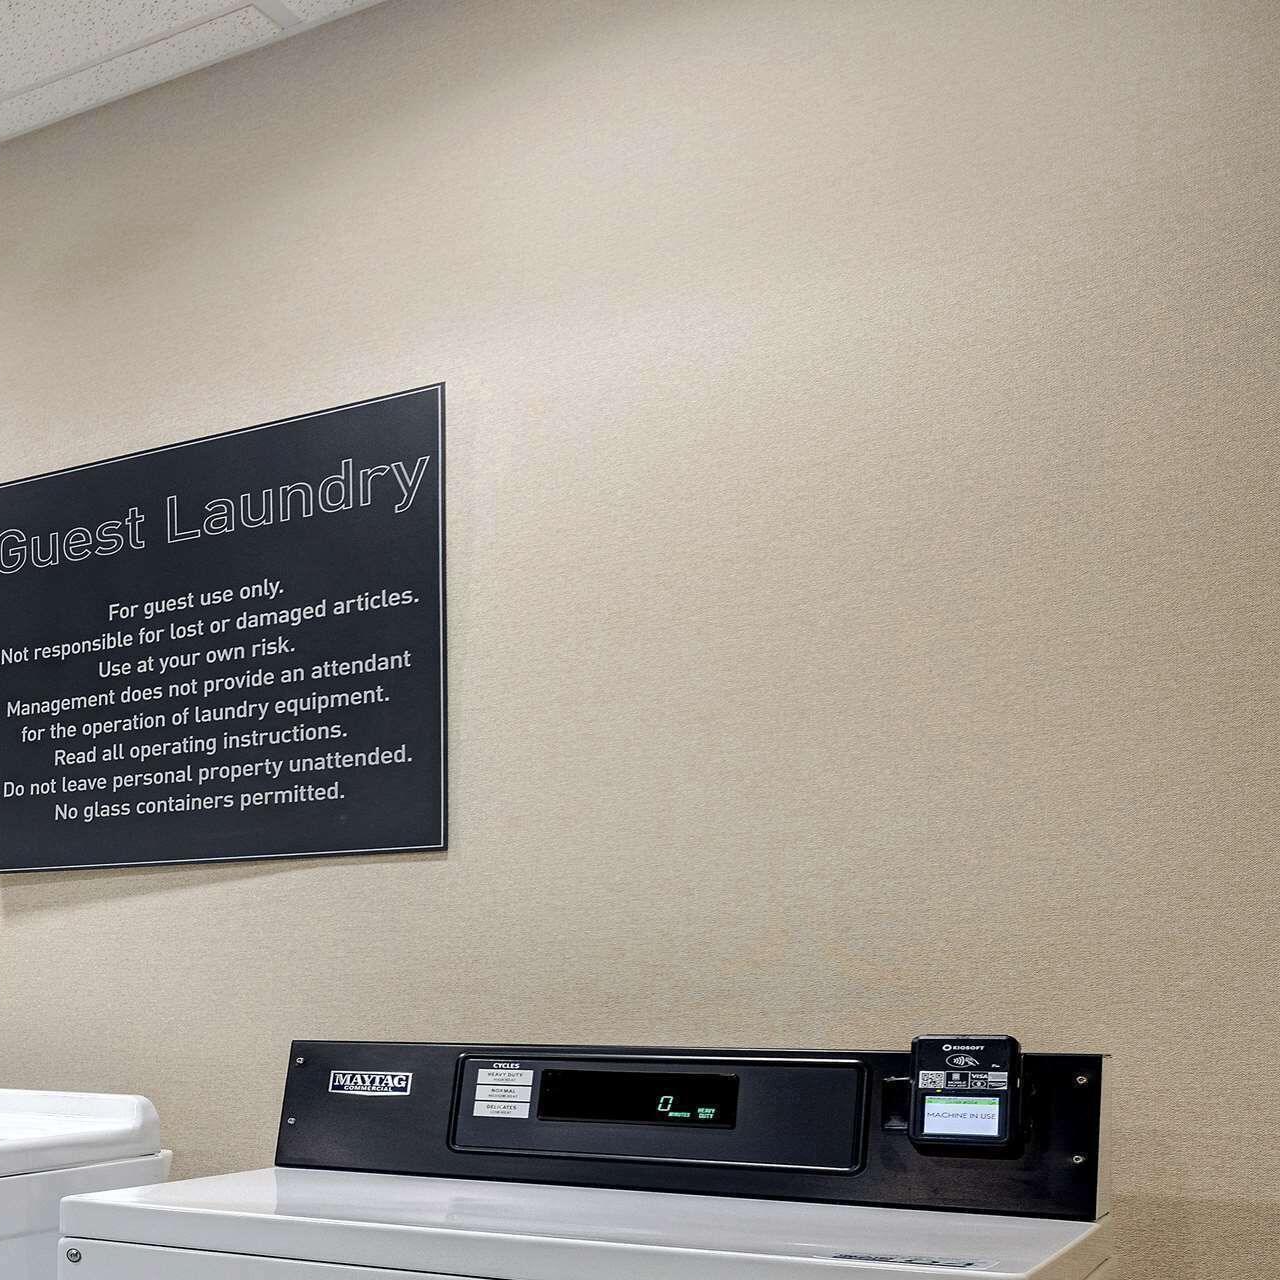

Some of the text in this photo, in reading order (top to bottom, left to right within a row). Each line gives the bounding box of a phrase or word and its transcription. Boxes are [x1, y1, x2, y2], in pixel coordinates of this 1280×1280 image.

[167, 455, 430, 543] Laundry
[109, 578, 284, 621] For guest use only.
[1, 589, 419, 665] Not responsible for lost or damaged articles.
[99, 636, 295, 678] Use at your own risk.
[7, 650, 411, 717] Management does not provide an attendant
[21, 685, 389, 742] for the operation of laundry equipment.
[55, 724, 347, 766] Read all operating instructions.
[4, 744, 412, 798] Do not leave personal property unattended.
[55, 781, 344, 822] No glass containers permitted.
[333, 1073, 407, 1088] MAYTAG
[980, 1112, 997, 1120] USE
